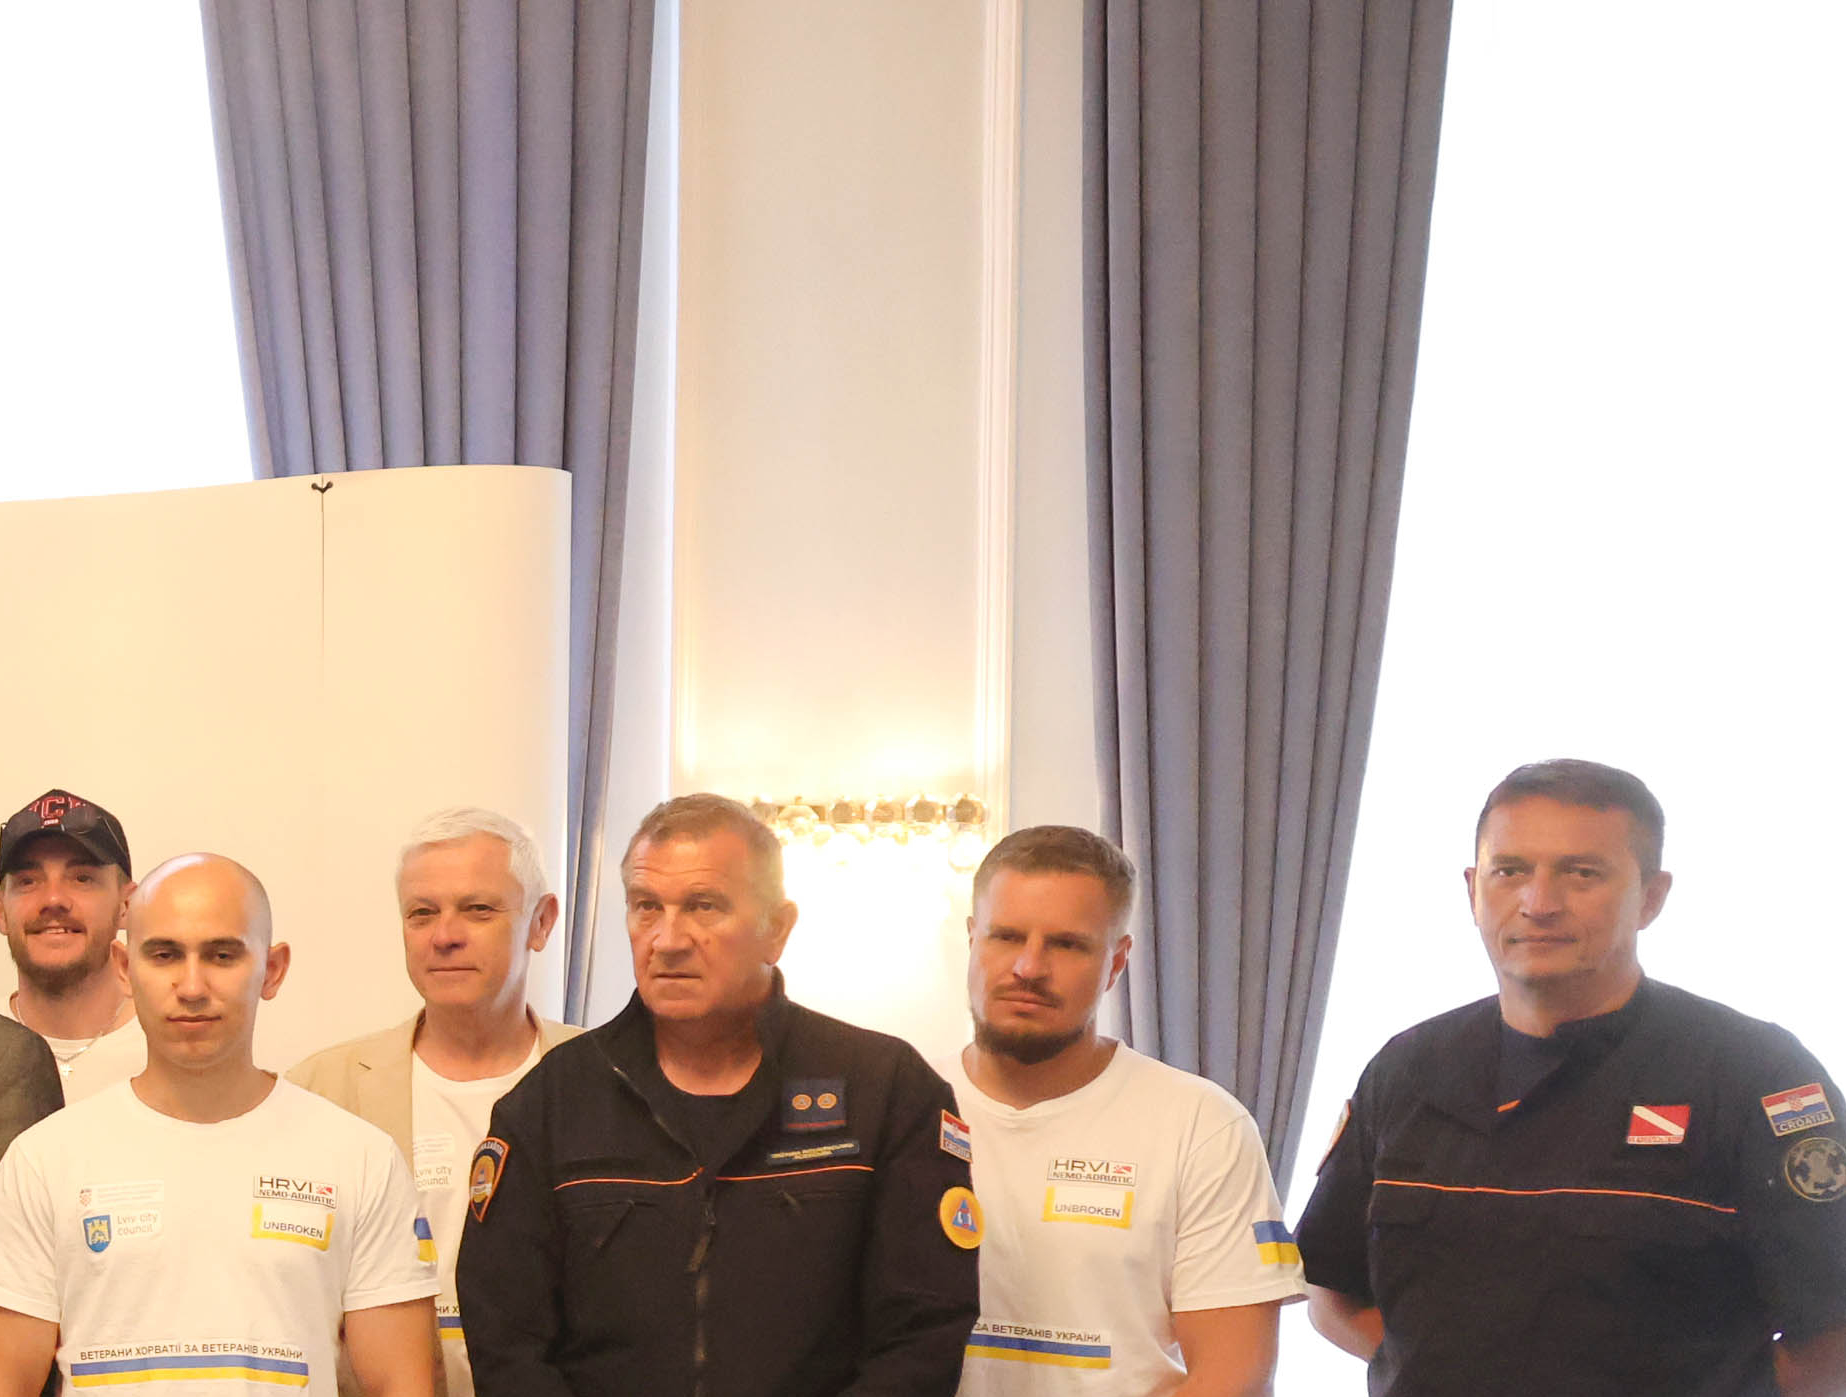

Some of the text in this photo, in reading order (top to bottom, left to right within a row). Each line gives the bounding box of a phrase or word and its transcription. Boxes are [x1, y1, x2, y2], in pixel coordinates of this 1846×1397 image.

[1777, 1111, 1831, 1132] CROATIA
[1053, 1159, 1110, 1174] HRVI
[259, 1175, 313, 1193] HRVI
[1054, 1203, 1121, 1218] UNBROKEN
[263, 1220, 324, 1239] UNBROKEN
[992, 1324, 1052, 1339] ВЕТЕРАНІВ
[1055, 1330, 1101, 1343] УКРАЇНИ
[79, 1343, 303, 1361] ВЕТЕРАНИ ХОРВАТІЇ ЗА ВЕТЕРАНІВ УКРАЇНИ
